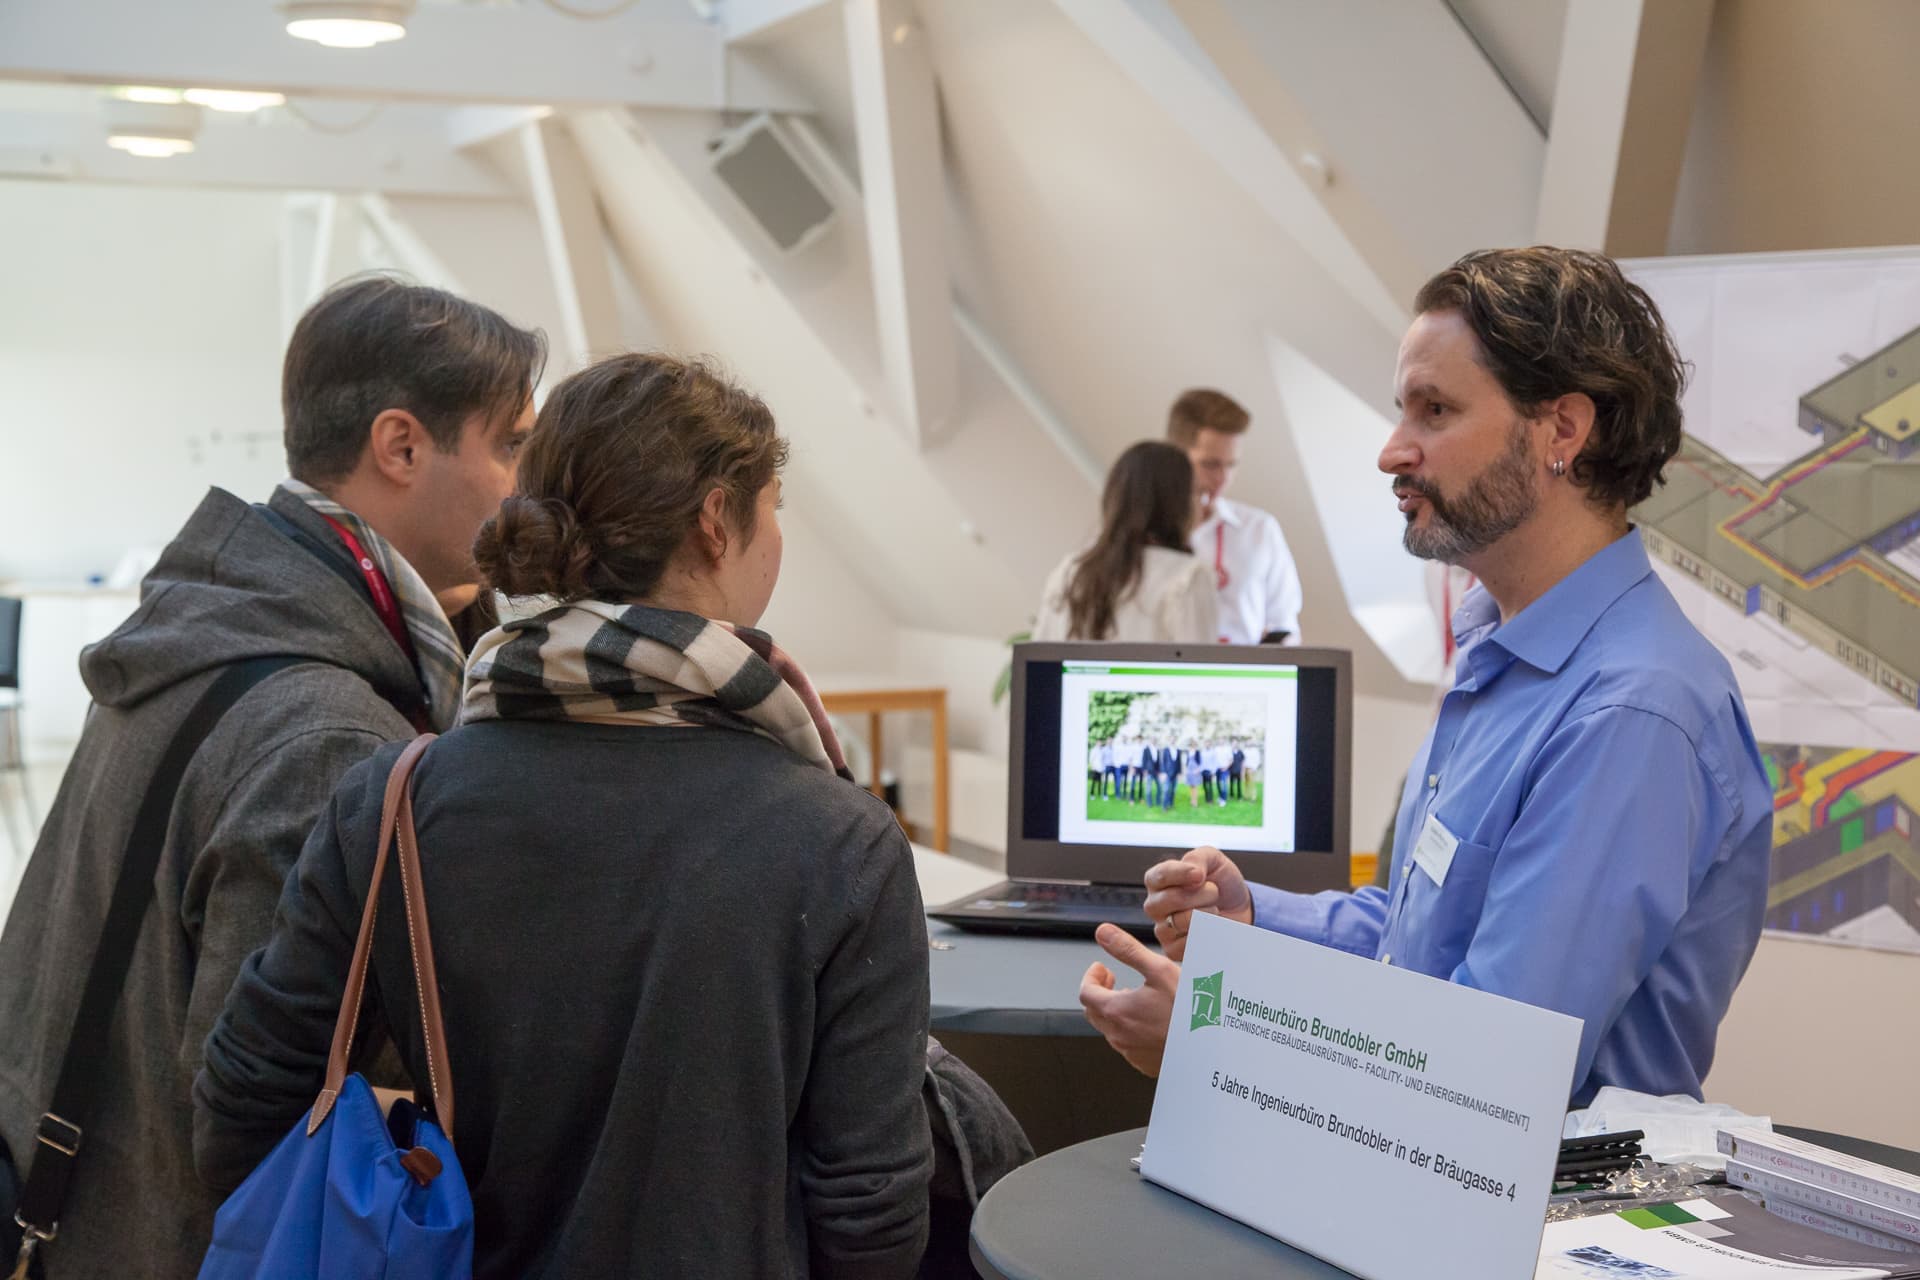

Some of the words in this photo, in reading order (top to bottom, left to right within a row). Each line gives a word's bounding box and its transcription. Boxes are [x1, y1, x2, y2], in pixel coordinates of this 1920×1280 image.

[1223, 1014, 1270, 1040] [TECHNISCHE
[1270, 1029, 1358, 1070] GEBÄUDEAUSRÜSTUNG
[1364, 1062, 1403, 1084] FACILITY-
[1404, 1075, 1423, 1092] UND
[1424, 1082, 1530, 1132] ENERGIEMANAGEMENT]
[1227, 991, 1308, 1033] Ingenieurbüro
[1311, 1017, 1382, 1057] Brundobler
[1384, 1041, 1428, 1072] GmbH
[1211, 1071, 1219, 1088] 5
[1221, 1074, 1249, 1100] Jahre
[1251, 1085, 1324, 1129] Ingenieurbüro
[1327, 1113, 1393, 1155] Brundobler
[1394, 1138, 1407, 1161] in
[1409, 1146, 1432, 1169] der
[1433, 1154, 1503, 1197] Bräugasse
[1507, 1183, 1516, 1202] 4
